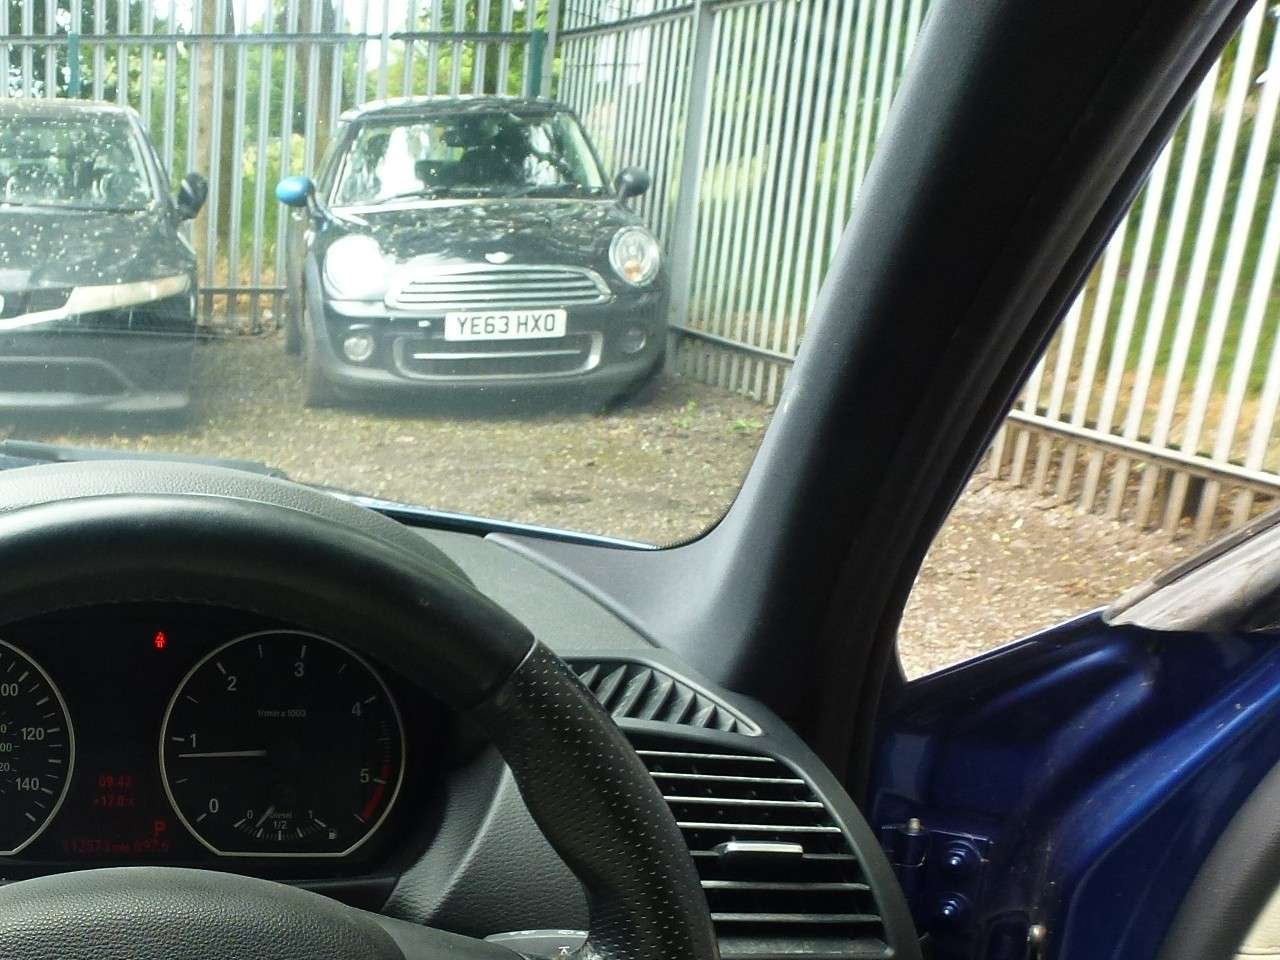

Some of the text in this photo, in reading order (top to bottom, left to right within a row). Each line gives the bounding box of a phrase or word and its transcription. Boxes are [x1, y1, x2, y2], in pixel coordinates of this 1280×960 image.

[457, 313, 556, 334] YE63 HXO
[294, 662, 305, 677] 3
[227, 676, 237, 691] 2
[351, 702, 362, 717] 4
[21, 727, 45, 741] 120
[190, 734, 197, 748] 1
[359, 768, 369, 783] 5
[15, 777, 40, 791] 140
[209, 798, 219, 814] 0
